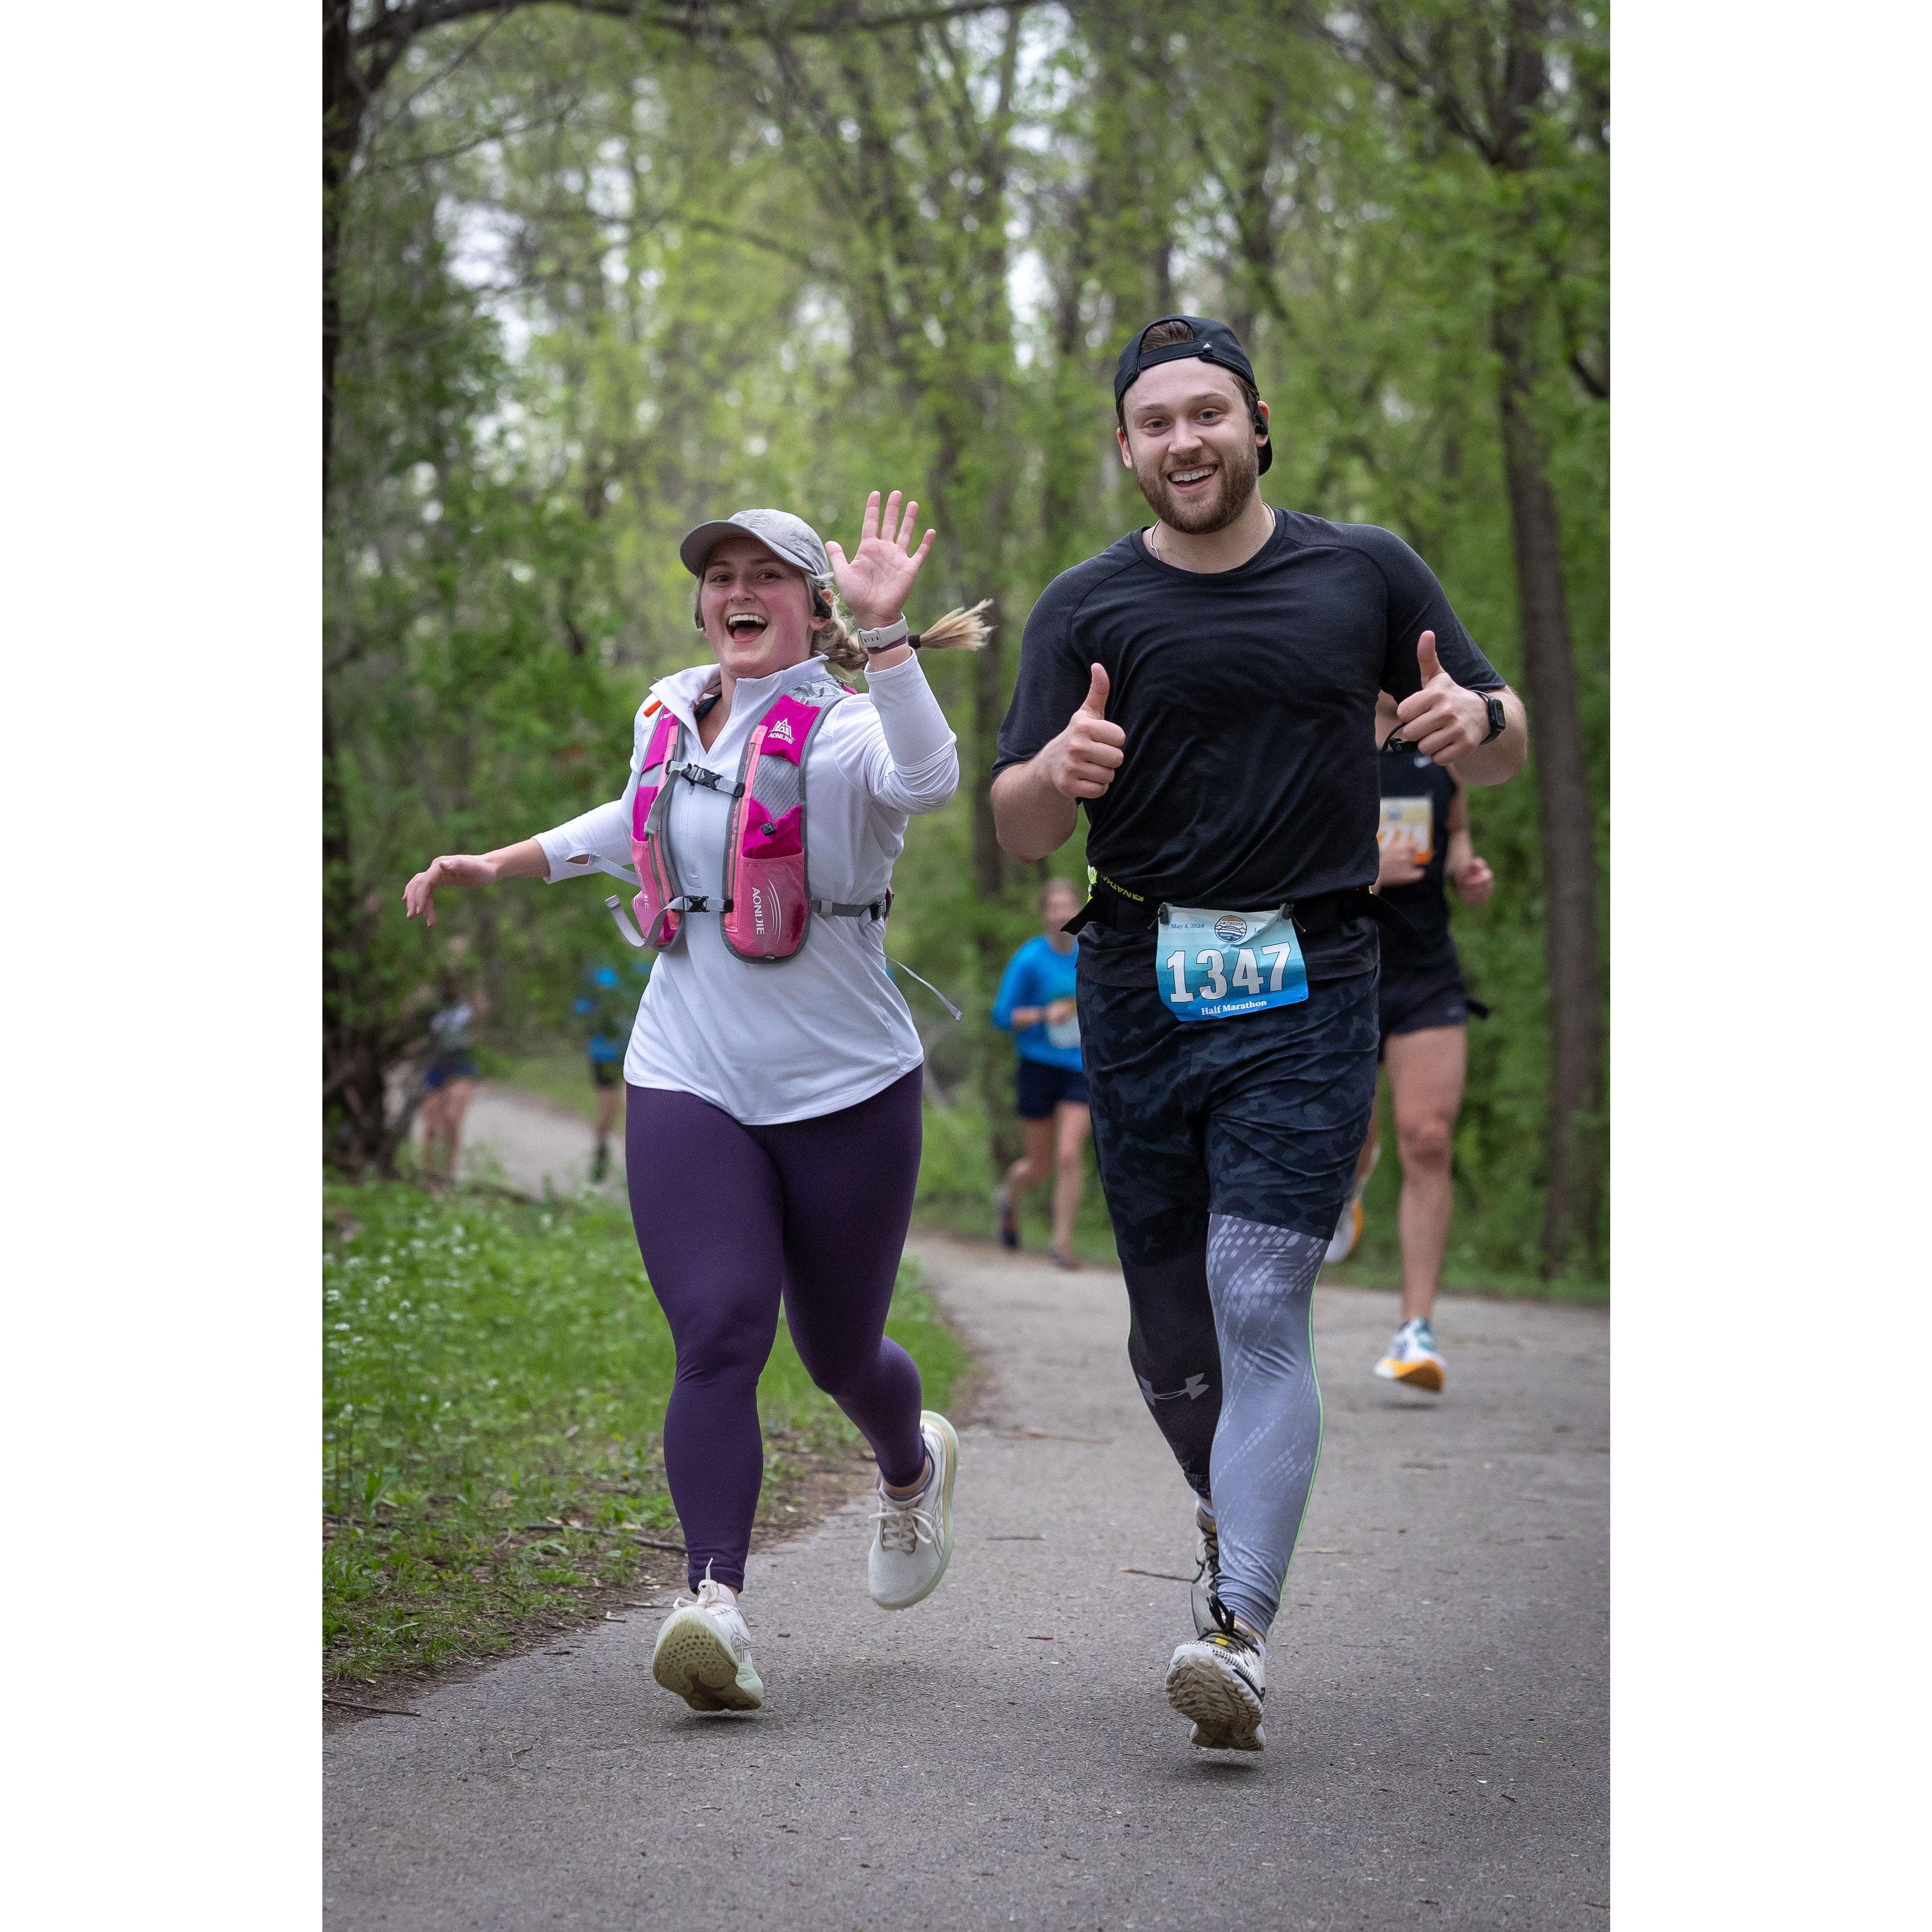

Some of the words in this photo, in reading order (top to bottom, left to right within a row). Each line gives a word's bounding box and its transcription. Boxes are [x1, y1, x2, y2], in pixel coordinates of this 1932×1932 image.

[767, 732, 794, 745] AONIJIE
[1100, 875, 1131, 898] NATHA
[752, 887, 765, 935] AONIJIE
[1167, 941, 1291, 1002] 1347
[1201, 1005, 1221, 1015] Half
[1222, 1001, 1267, 1012] Marathon
